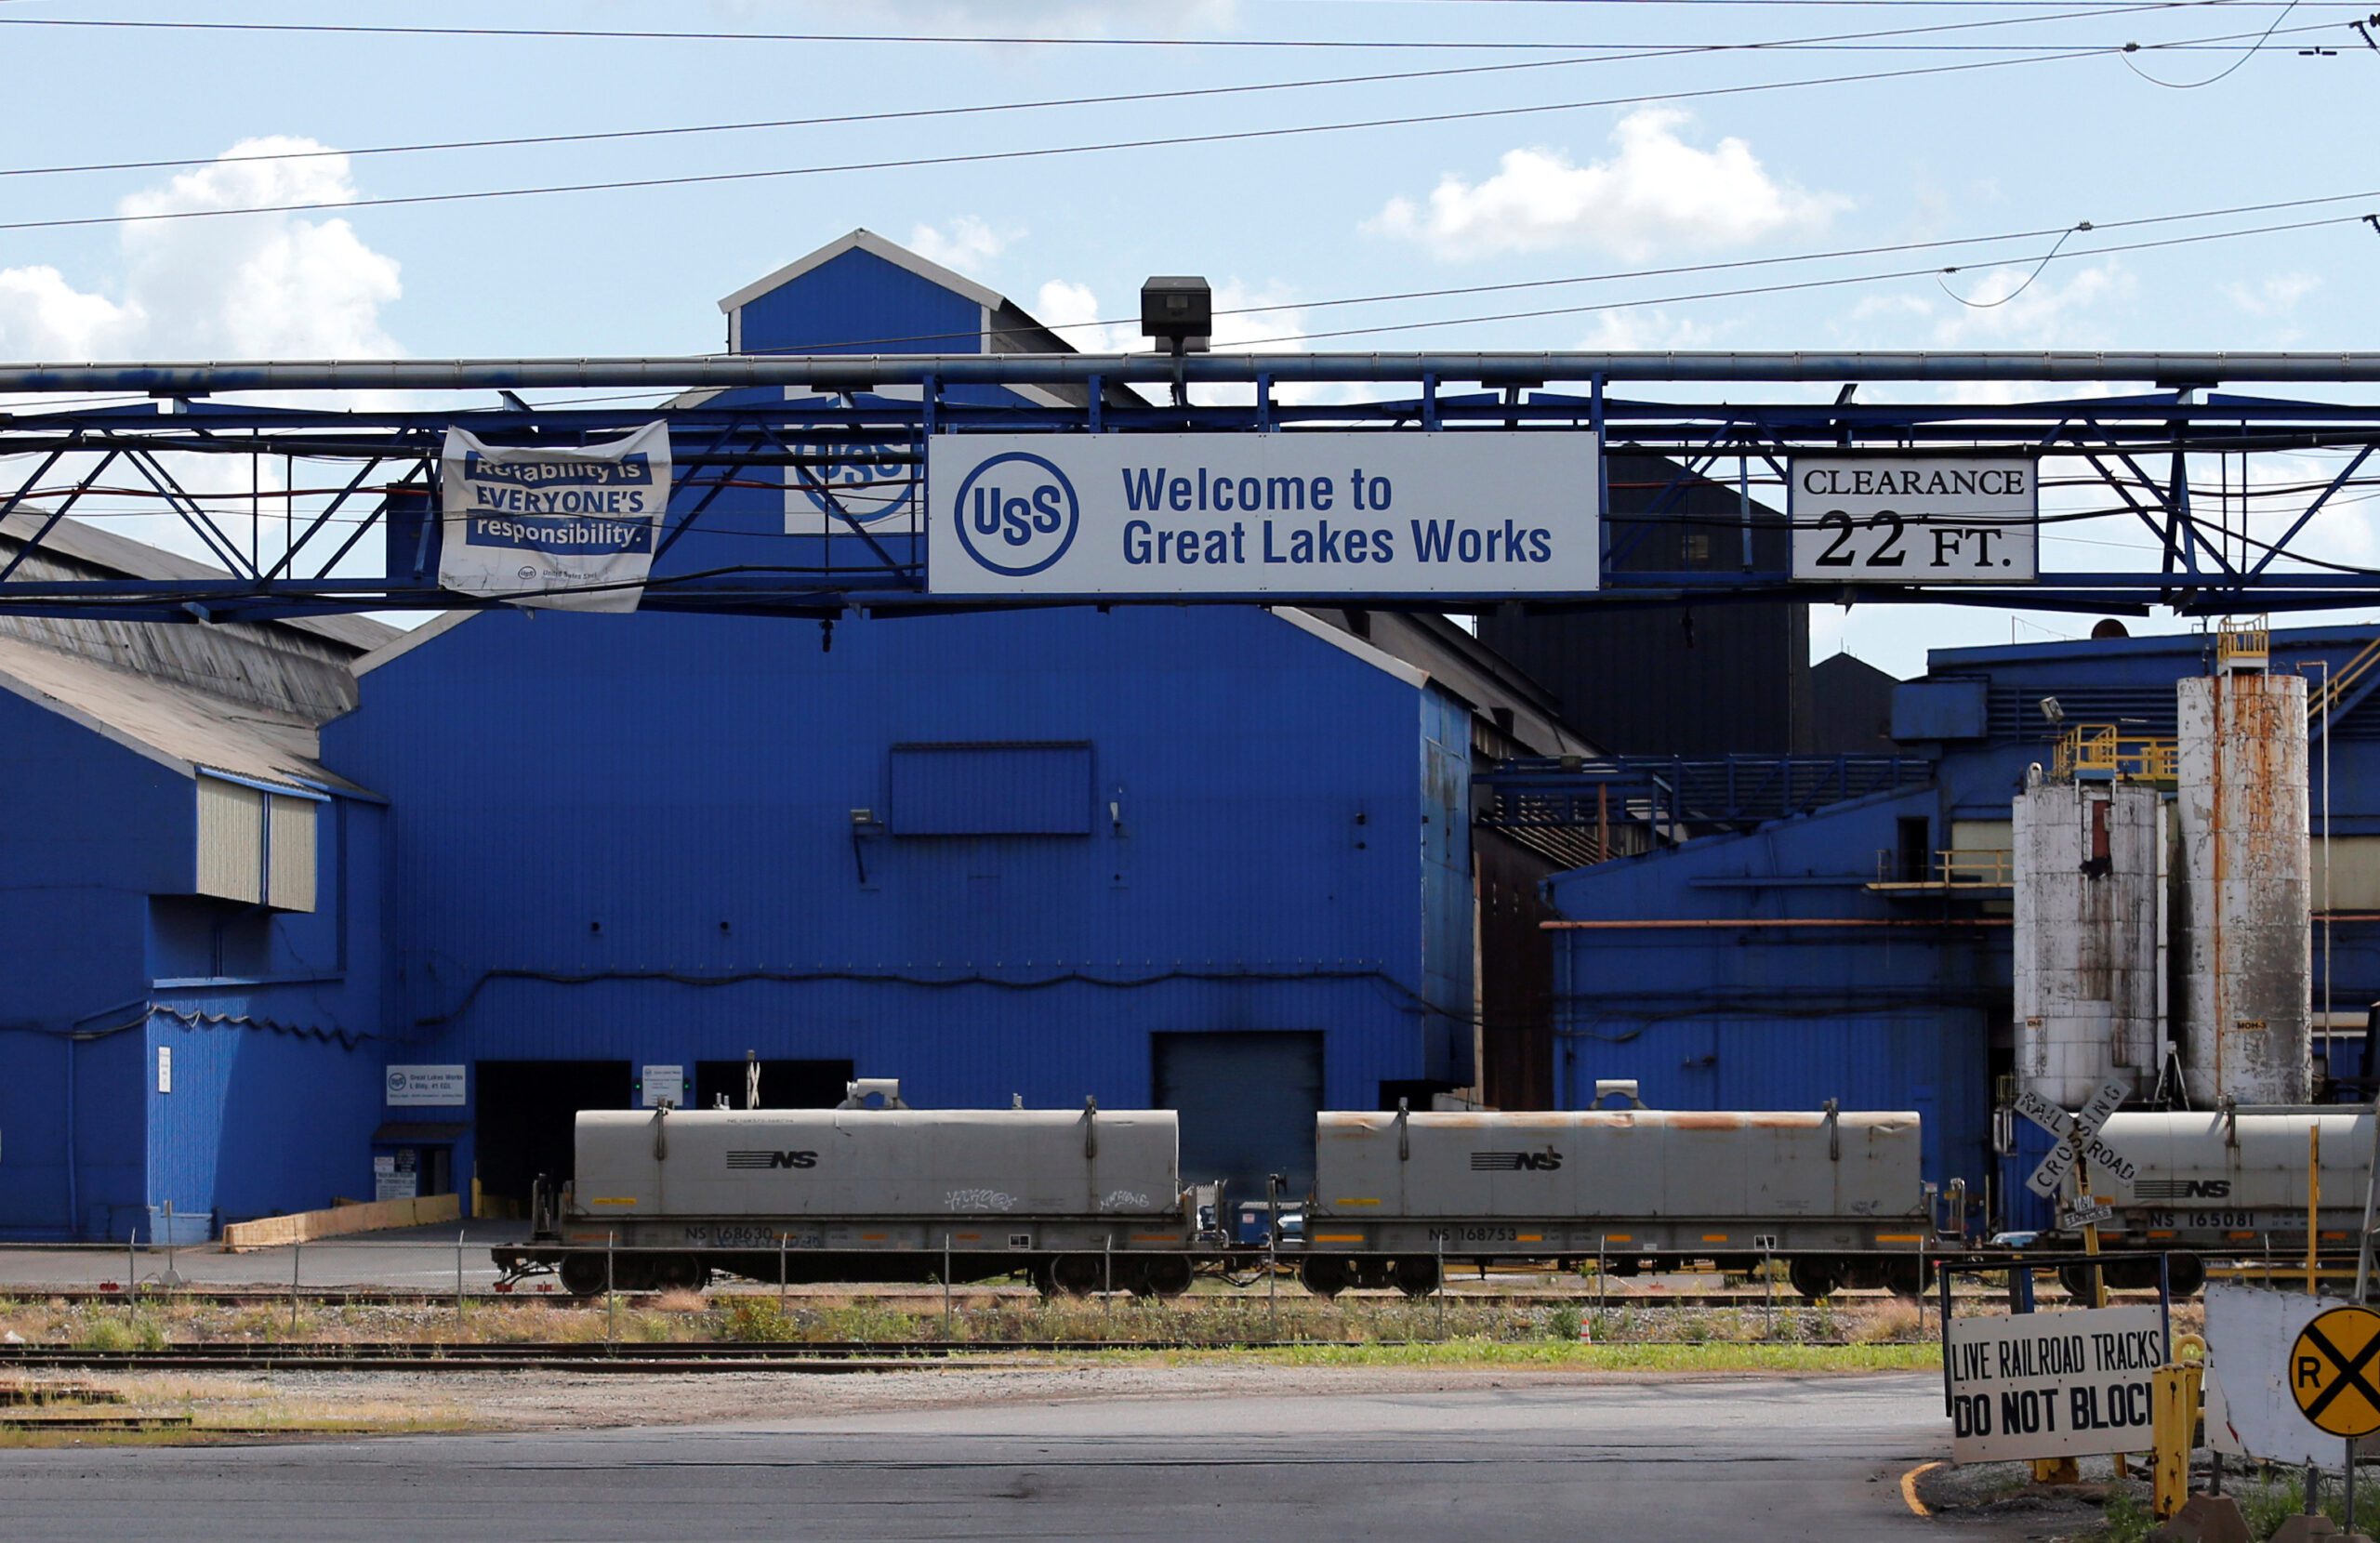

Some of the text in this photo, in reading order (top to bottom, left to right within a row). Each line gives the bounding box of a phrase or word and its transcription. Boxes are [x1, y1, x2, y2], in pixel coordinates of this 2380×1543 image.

[1122, 468, 1392, 512] Welcome to
[1804, 469, 2025, 495] CLEARANCE
[476, 485, 644, 513] EVERYONE'S
[973, 485, 1061, 547] USS
[477, 518, 641, 547] responsibility.
[1123, 519, 1552, 565] Great Lakes Works
[1815, 509, 2011, 567] 22 FT.
[2020, 1091, 2135, 1180] RAIL ROAD
[2036, 1085, 2121, 1188] CROSSING
[771, 1151, 818, 1169] NS
[1514, 1152, 1563, 1170] NS
[2185, 1180, 2231, 1198] NS
[685, 1227, 774, 1240] NS 168630
[2149, 1212, 2254, 1227] NS 165081
[1429, 1228, 1517, 1241] NS 168753
[1952, 1330, 2161, 1382] LIVE RAILROAD TRACKS
[1954, 1393, 1991, 1438] DO
[2002, 1389, 2059, 1435] NOT
